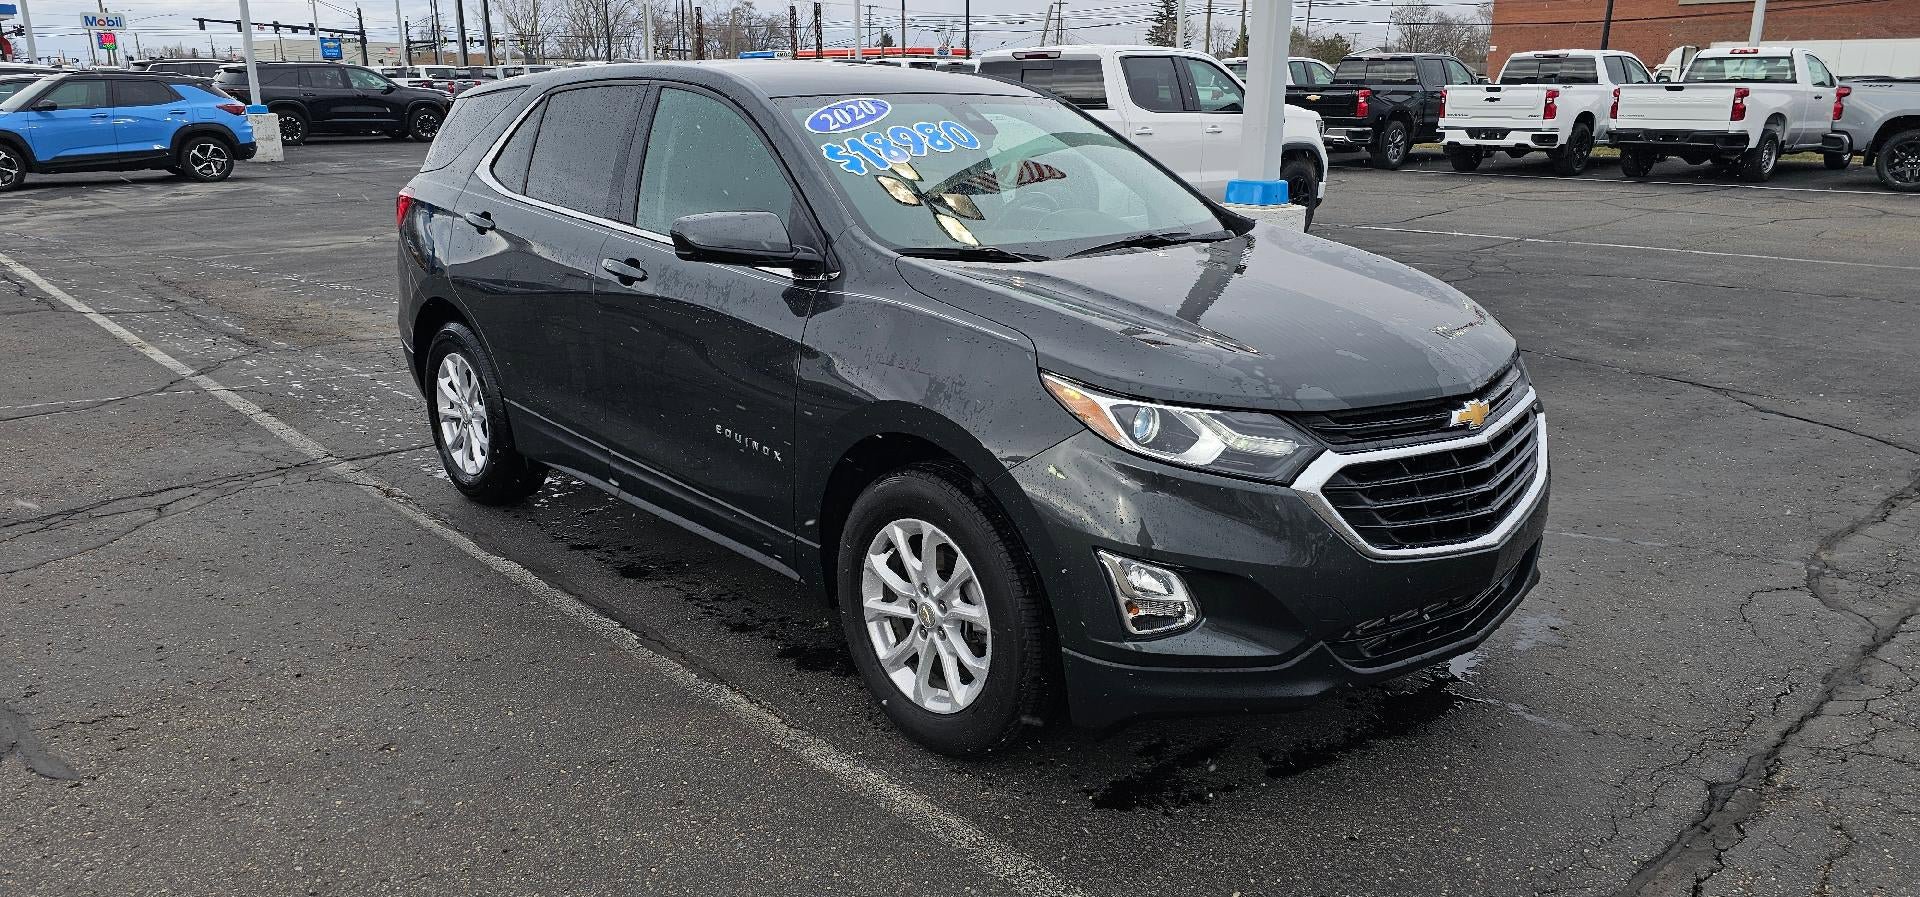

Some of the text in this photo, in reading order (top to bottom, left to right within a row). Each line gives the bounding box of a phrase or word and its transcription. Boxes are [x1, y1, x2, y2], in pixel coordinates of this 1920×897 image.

[83, 15, 123, 28] Mobil
[819, 99, 878, 131] 2020
[820, 120, 982, 176] $18980
[715, 424, 783, 462] EQUINOX
